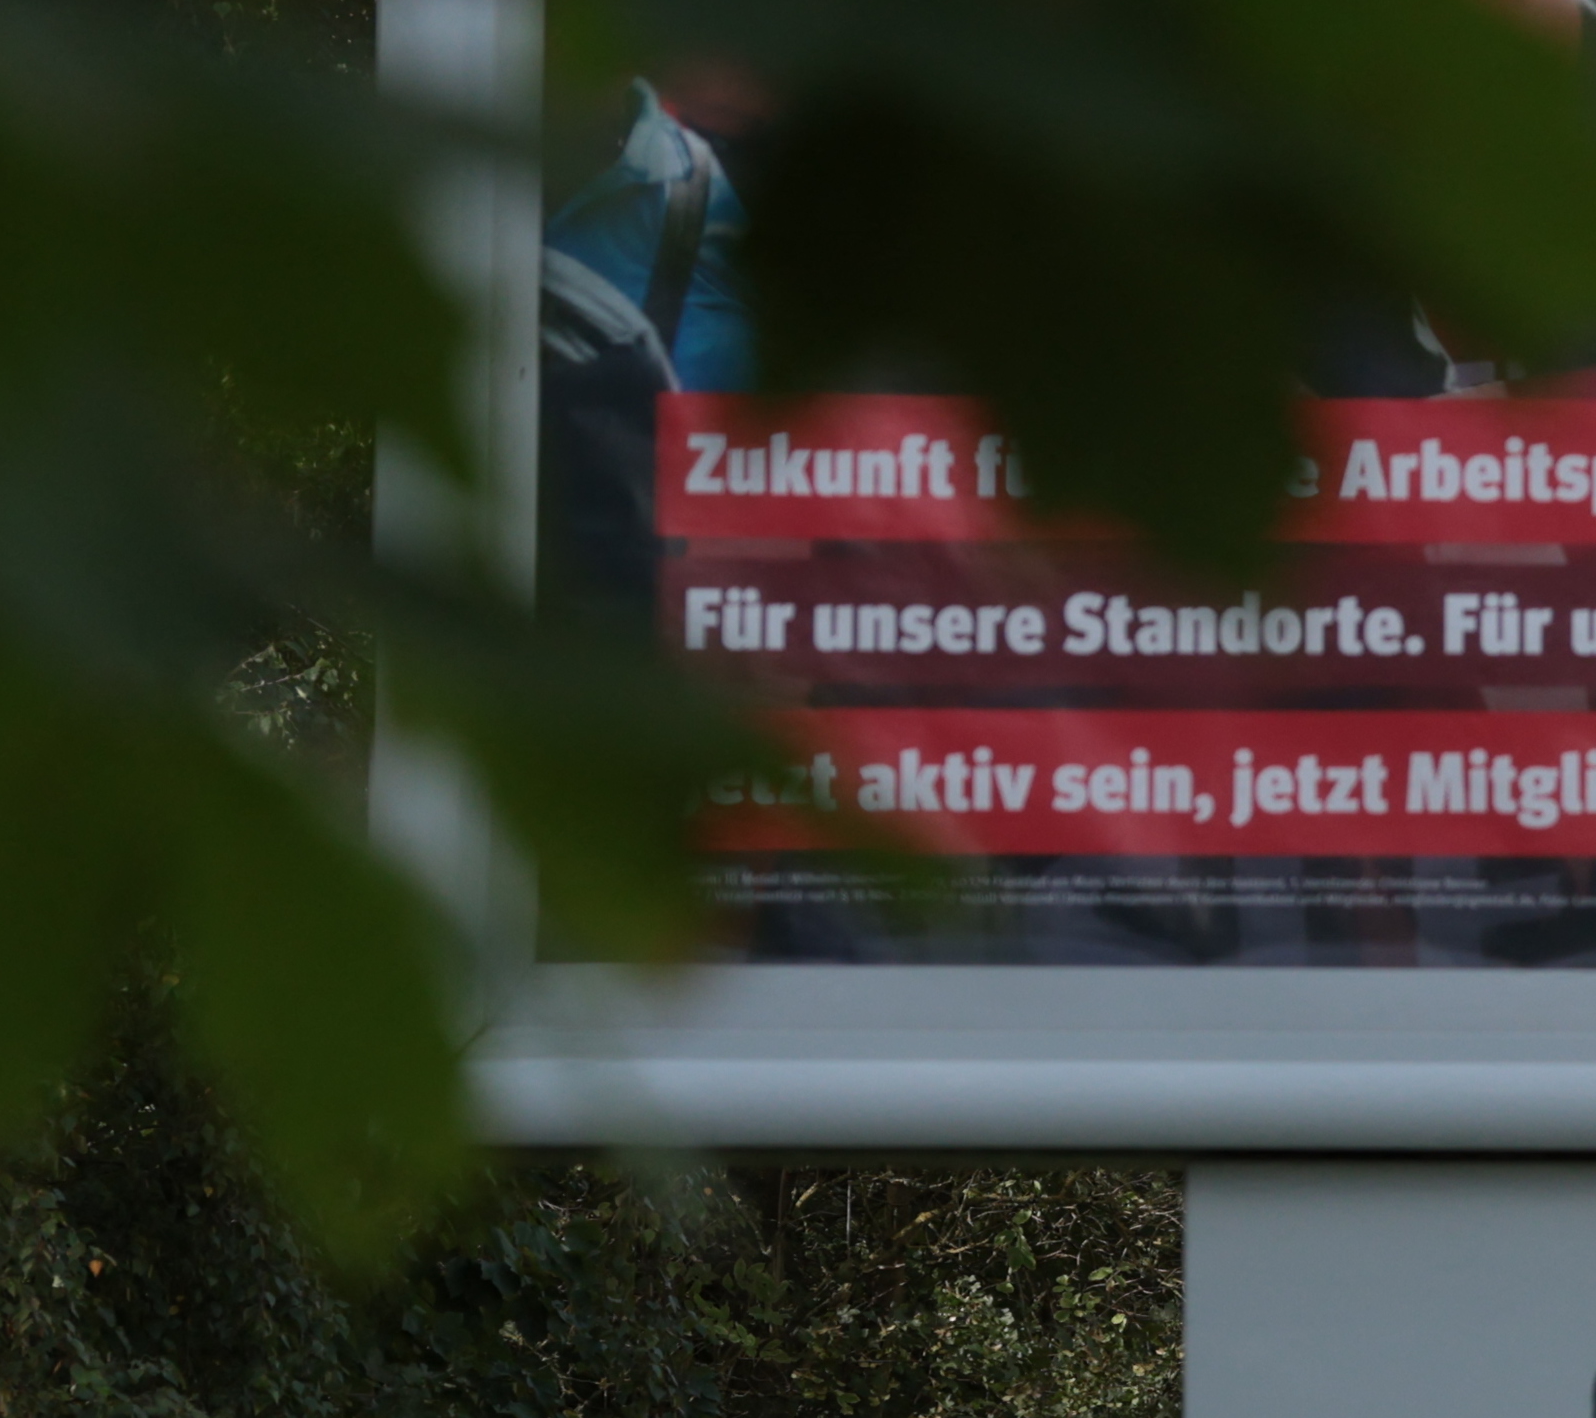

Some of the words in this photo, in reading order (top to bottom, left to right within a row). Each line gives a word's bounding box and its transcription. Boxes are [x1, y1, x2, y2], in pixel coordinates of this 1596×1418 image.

[685, 433, 954, 501] Zukunft
[685, 586, 794, 652] Für
[814, 599, 1044, 655] unsere
[1064, 593, 1424, 659] Standorte.
[1444, 596, 1550, 659] Für
[860, 748, 1033, 814] aktiv
[1054, 752, 1214, 821] sein,
[1229, 751, 1387, 826] jetzt
